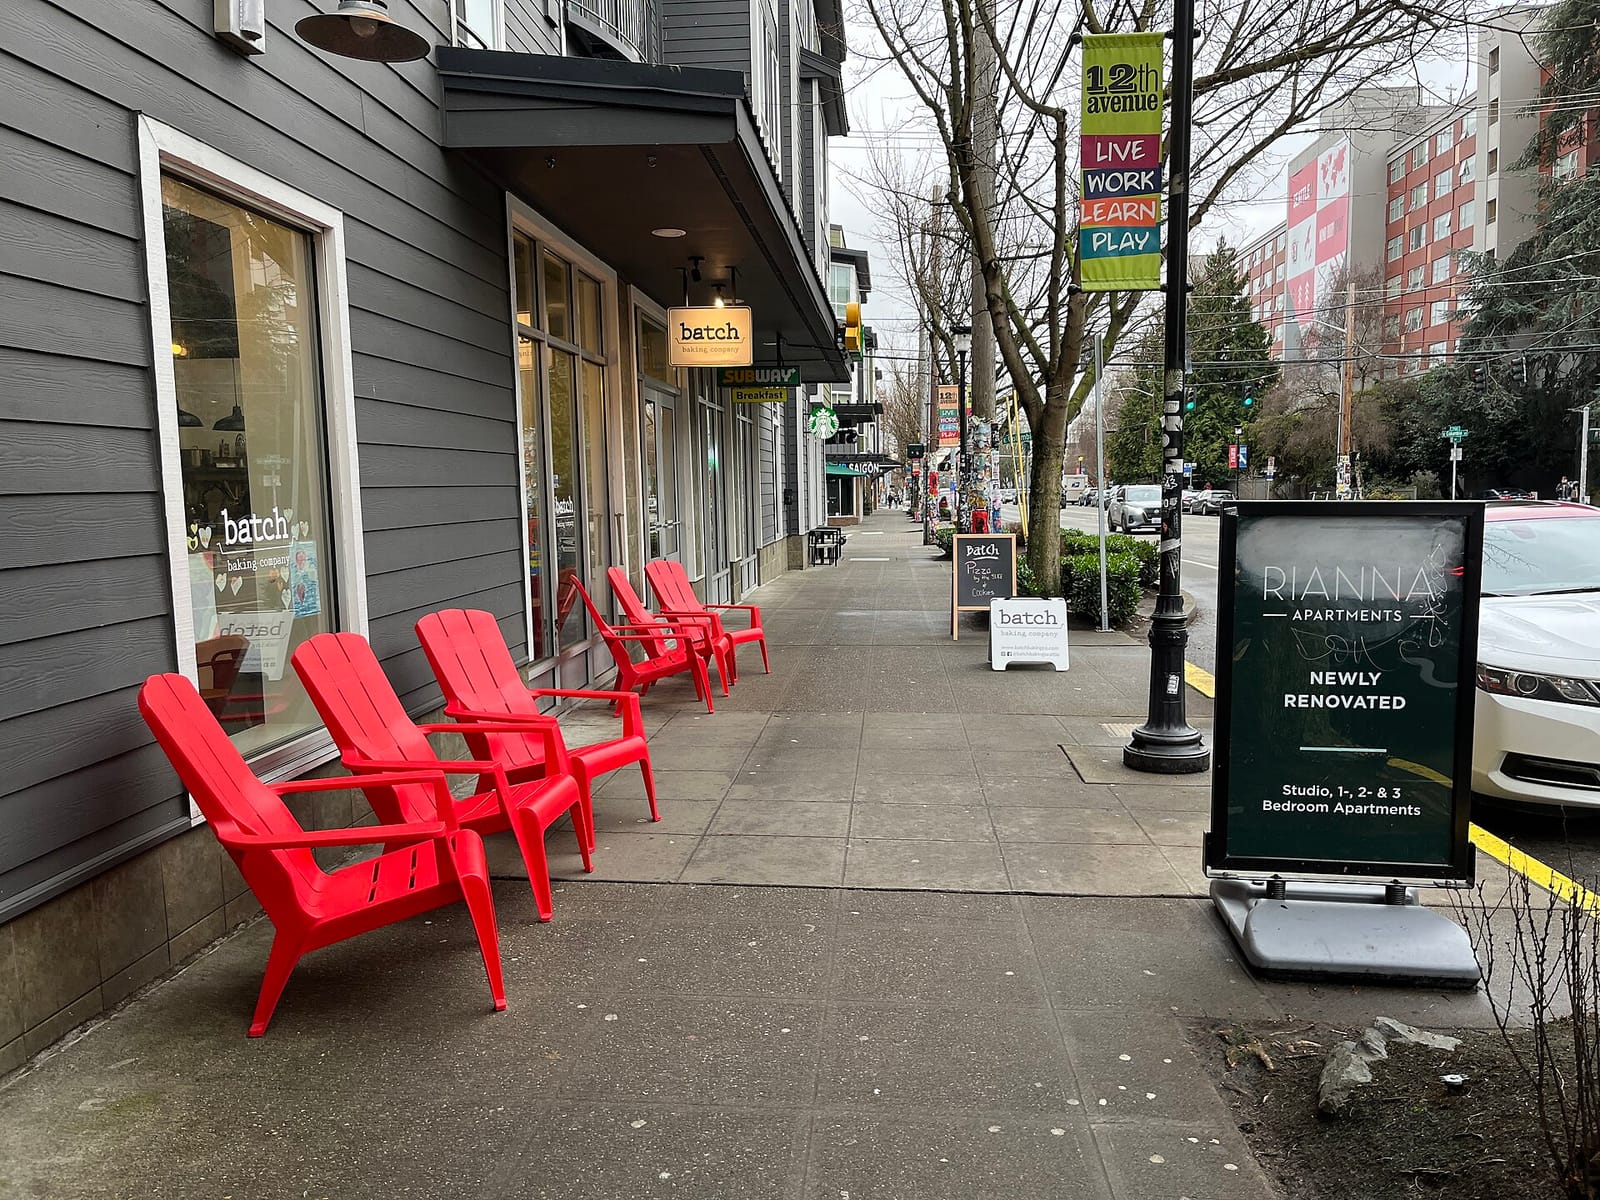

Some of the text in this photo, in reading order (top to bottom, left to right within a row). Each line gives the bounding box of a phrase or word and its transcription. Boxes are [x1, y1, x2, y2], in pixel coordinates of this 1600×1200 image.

[1086, 62, 1158, 95] 12th
[1087, 93, 1158, 114] avenue
[1096, 139, 1146, 162] LIVE
[1087, 170, 1155, 193] WORK
[1080, 200, 1156, 223] LEARN
[1092, 231, 1150, 252] PLAY
[679, 321, 740, 341] batch
[682, 346, 739, 355] baking company
[724, 368, 797, 383] SUBWAY
[736, 390, 783, 400] Breakfast
[221, 506, 289, 546] batch
[966, 543, 1000, 557] Batch
[227, 555, 290, 572] baking company
[965, 561, 991, 575] Pizza
[1263, 566, 1436, 601] RIANNA
[999, 609, 1058, 625] batch
[1292, 609, 1402, 622] APARTMENTS
[1001, 630, 1058, 639] baking company
[1310, 671, 1381, 686] NEWLY
[1284, 694, 1406, 710] RENOVATED
[1282, 785, 1401, 799] Studio, 1-, 2- & 3
[1262, 800, 1421, 816] Bedroom Apartments
